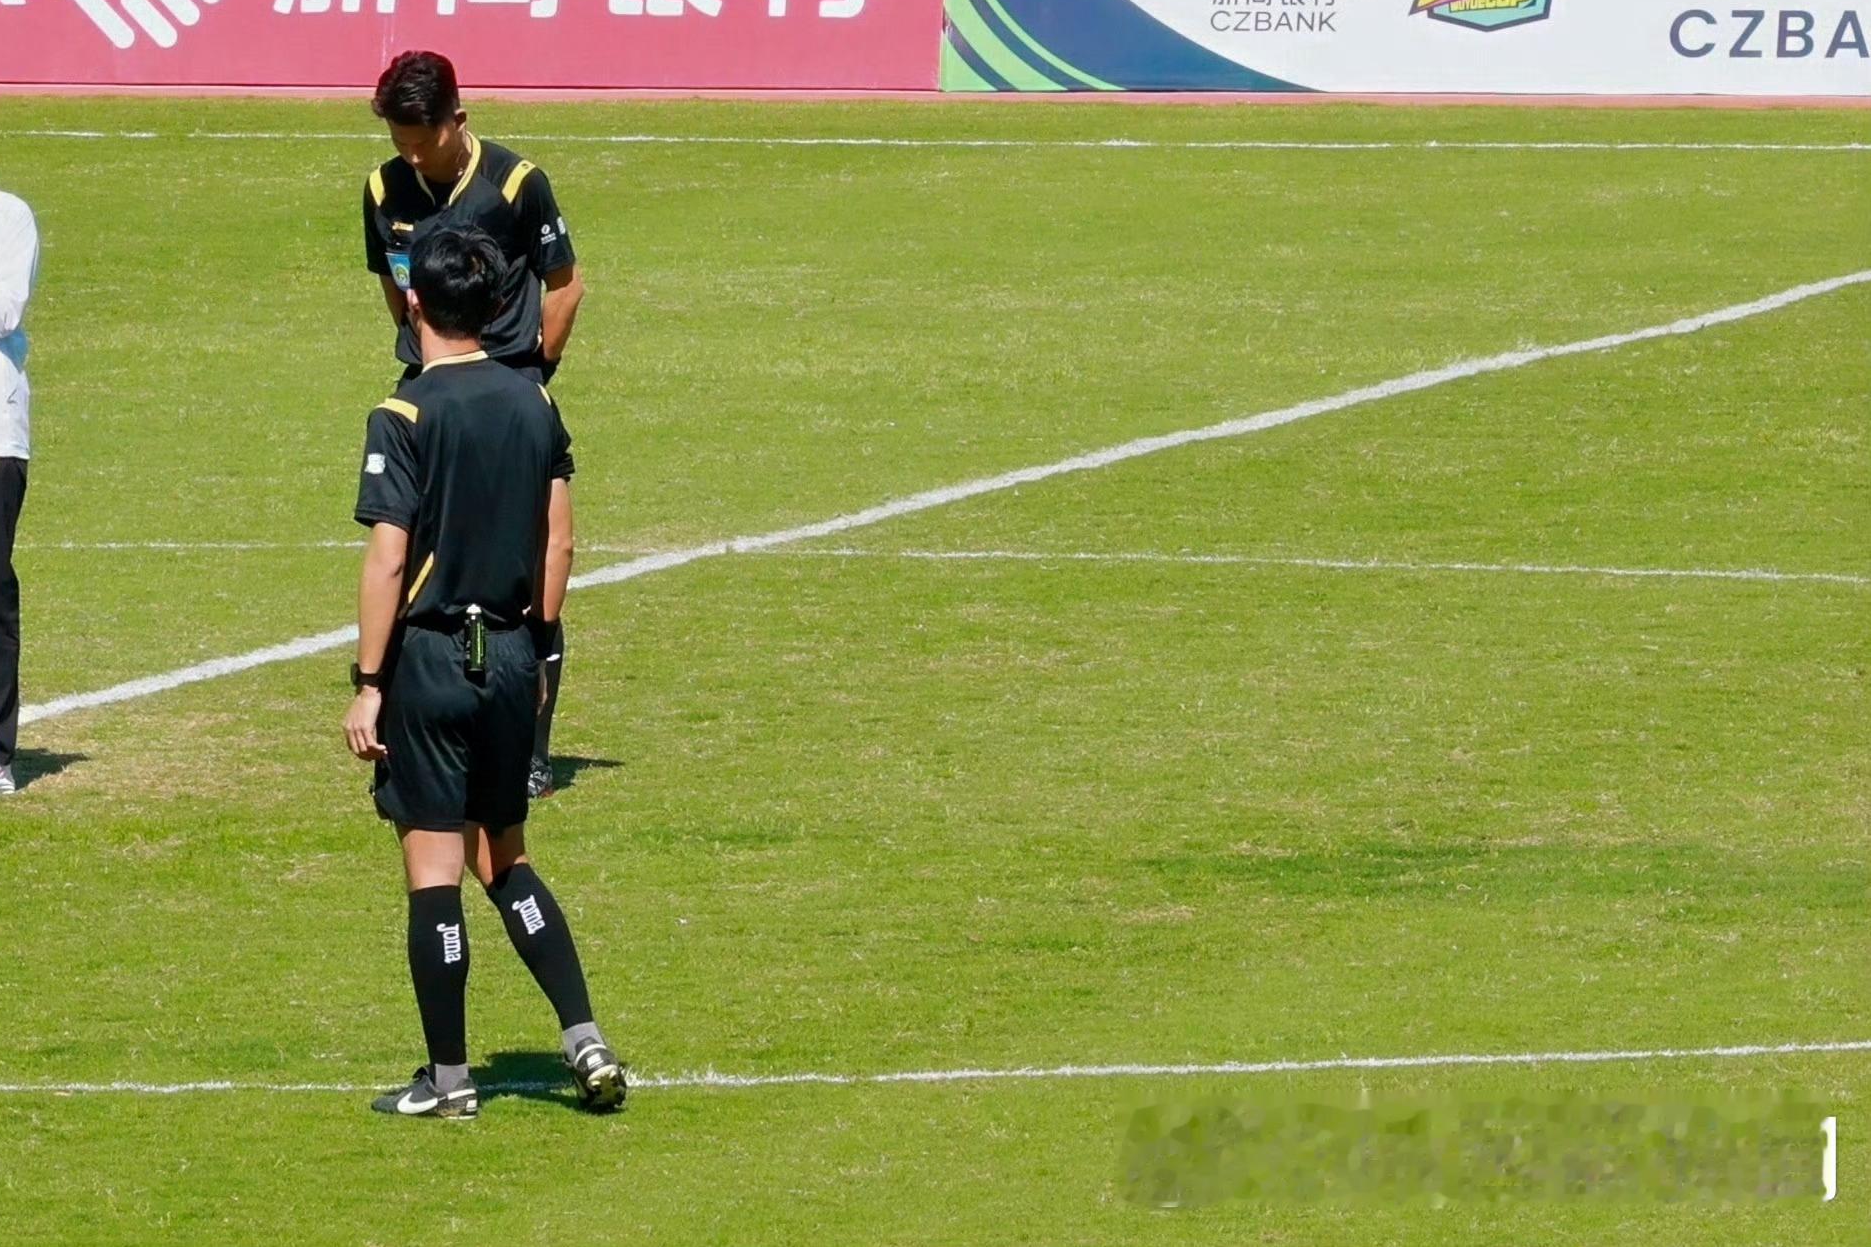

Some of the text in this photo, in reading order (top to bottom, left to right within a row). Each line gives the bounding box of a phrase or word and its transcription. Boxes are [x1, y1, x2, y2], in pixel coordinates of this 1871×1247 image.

[1210, 10, 1337, 32] CZBANK
[1669, 9, 1871, 58] CZBA
[512, 894, 545, 935] Joma
[436, 923, 461, 964] Joma
